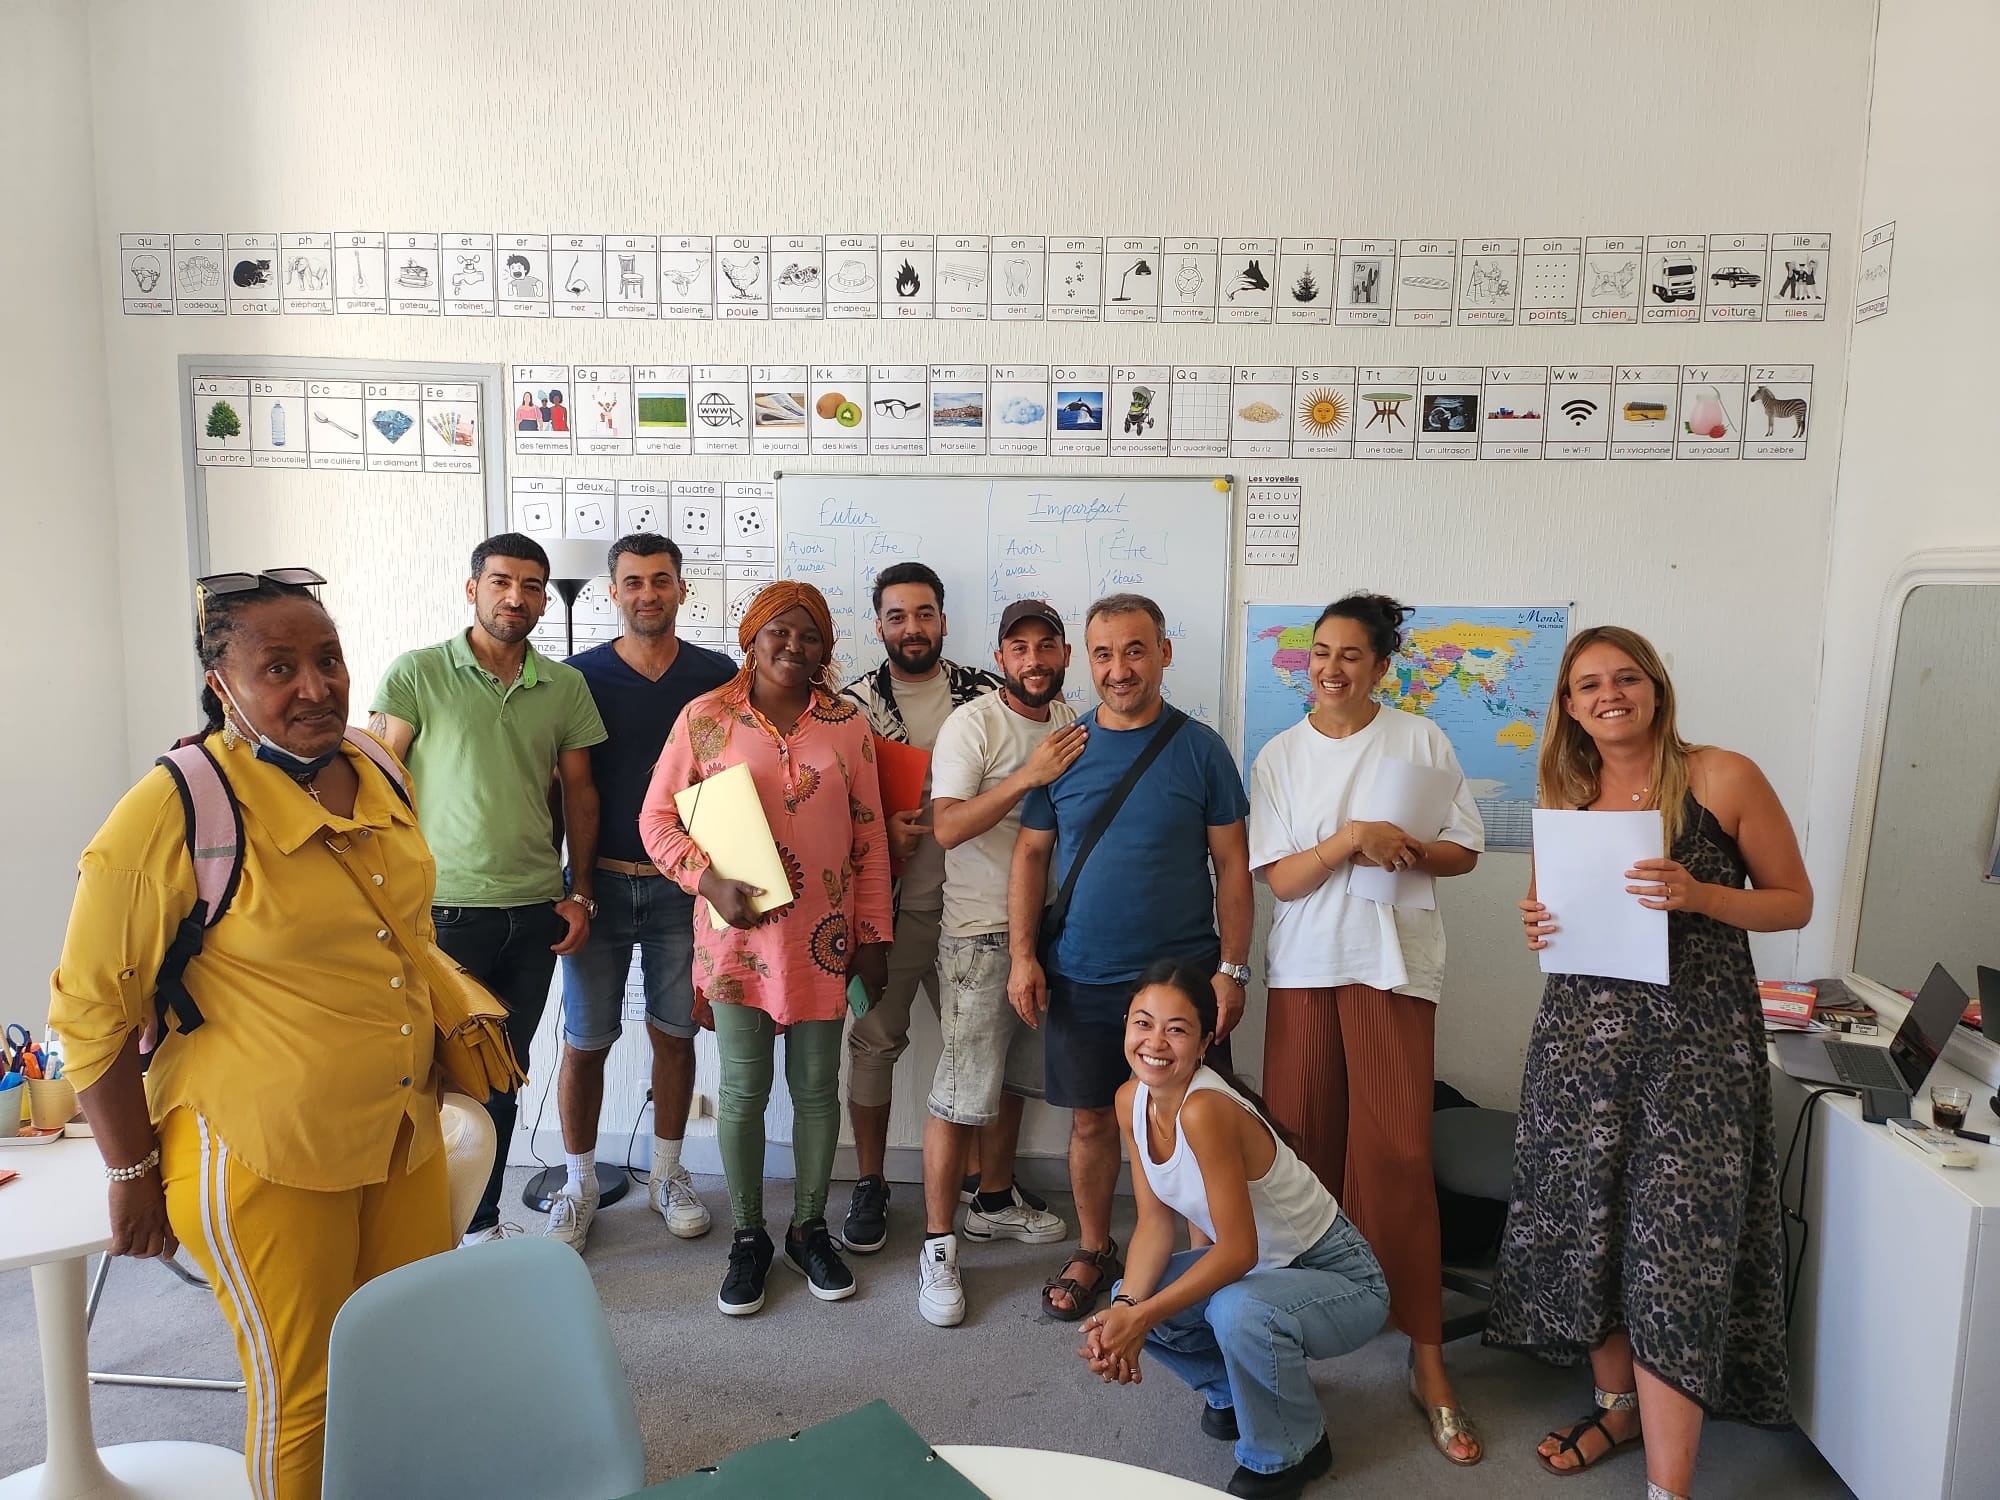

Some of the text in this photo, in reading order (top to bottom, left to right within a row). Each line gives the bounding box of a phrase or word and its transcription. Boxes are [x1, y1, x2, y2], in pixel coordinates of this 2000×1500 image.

[137, 237, 152, 247] qu
[194, 238, 201, 246] c
[245, 236, 259, 246] ch
[298, 236, 313, 247] ph
[351, 236, 366, 246] gu
[408, 237, 416, 247] g
[461, 237, 473, 246] et
[516, 238, 528, 246] er
[570, 239, 583, 247] ez
[625, 239, 636, 248] ai
[680, 239, 691, 249] ei
[788, 239, 804, 249] au
[840, 238, 863, 247] eau
[900, 239, 914, 248] eu
[955, 239, 970, 248] an
[1010, 240, 1026, 249] en
[1066, 240, 1085, 250] em
[1124, 240, 1143, 250] am
[1183, 241, 1199, 250] on
[1239, 241, 1259, 250] om
[1605, 239, 1624, 250] ien
[1666, 239, 1687, 249] ion
[1733, 238, 1745, 248] oi
[1793, 236, 1811, 247] ille
[1303, 242, 1314, 251] in
[1361, 242, 1375, 252] im
[1419, 243, 1438, 253] ain
[1481, 242, 1501, 252] ein
[1542, 241, 1562, 252] oin
[133, 302, 163, 310] casque
[184, 301, 219, 310] cadeaux
[242, 302, 267, 312] chat
[346, 300, 376, 310] guitare
[454, 302, 484, 310] robinet
[514, 303, 533, 312] crier
[571, 304, 586, 312] nez
[618, 304, 646, 314] chaise
[670, 305, 704, 314] baleine
[774, 305, 821, 314] chaussures
[833, 304, 871, 314] chapeau
[950, 305, 972, 314] banc
[726, 306, 759, 318] poule
[898, 306, 917, 316] feu
[1007, 306, 1027, 315] dent
[1051, 307, 1095, 317] empreinte
[1117, 308, 1144, 318] lampe
[1172, 309, 1204, 317] montre
[1230, 309, 1259, 318] ombre
[1292, 309, 1316, 320] sapin
[1591, 309, 1627, 320] chien
[1647, 308, 1696, 319] camion
[1711, 306, 1756, 318] voiture
[1785, 308, 1808, 318] filles
[1349, 311, 1378, 320] timbre
[1413, 311, 1434, 322] pain
[1467, 311, 1505, 322] peinture
[1528, 309, 1567, 322] points
[520, 442, 569, 450] des femmes
[646, 443, 661, 451] une
[706, 442, 738, 450] internet
[762, 442, 800, 451] le journal
[822, 442, 858, 450] des kiwis
[874, 443, 924, 451] des lunettes
[940, 442, 976, 450] Marseille
[1010, 443, 1038, 452] nuage
[1076, 444, 1101, 453] orque
[1112, 444, 1167, 453] une poussette
[1172, 444, 1181, 452] un
[1250, 444, 1271, 453] du riz
[1382, 446, 1403, 454] table
[1437, 446, 1470, 454] ultrason
[1513, 446, 1529, 454] ville
[1562, 446, 1570, 454] le
[1626, 446, 1670, 455] xylophone
[1688, 446, 1730, 455] un yaourt
[1757, 446, 1768, 454] un
[205, 454, 245, 463] un arbre
[271, 454, 306, 464] bouteille
[314, 457, 327, 465] une
[386, 458, 418, 468] diamant
[432, 460, 472, 469] des euros
[1264, 475, 1300, 483] voyelles
[530, 482, 544, 491] un
[576, 481, 604, 492] deux
[631, 483, 655, 493] trois
[677, 484, 715, 494] quatre
[737, 486, 762, 496] cinq
[693, 547, 700, 555] 4
[746, 549, 752, 558] 5
[685, 566, 711, 576] neuf
[742, 567, 759, 577] dix
[538, 626, 545, 635] 6
[590, 628, 596, 636] 7
[695, 629, 702, 638] 9
